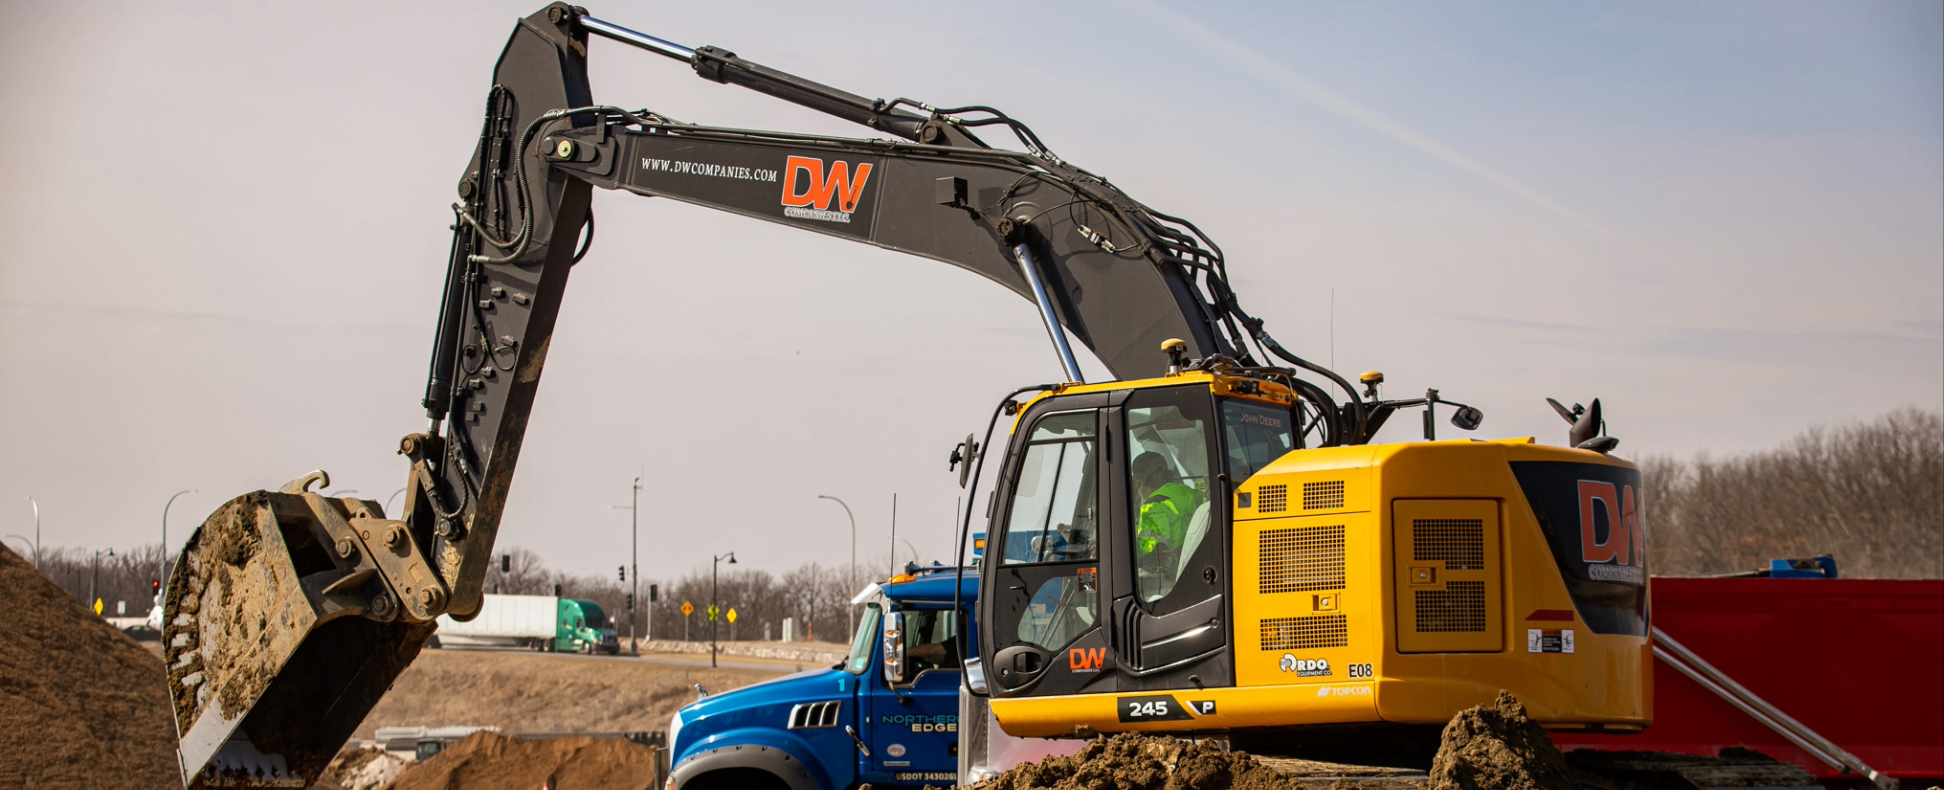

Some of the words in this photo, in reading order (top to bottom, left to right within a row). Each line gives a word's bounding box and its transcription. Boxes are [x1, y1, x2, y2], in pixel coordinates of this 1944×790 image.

[641, 157, 778, 182] WWW.DWCOMPANIES.COM
[781, 155, 874, 213] DW
[1241, 412, 1259, 424] JOHN
[1260, 415, 1282, 427] DEERE
[1069, 647, 1107, 669] DW
[1348, 663, 1373, 678] E08
[837, 678, 845, 692] 1
[1332, 686, 1371, 697] TOPCON
[1129, 701, 1168, 717] 245
[1202, 701, 1214, 714] P
[882, 714, 959, 727] NORTHER
[911, 723, 957, 732] EDGE
